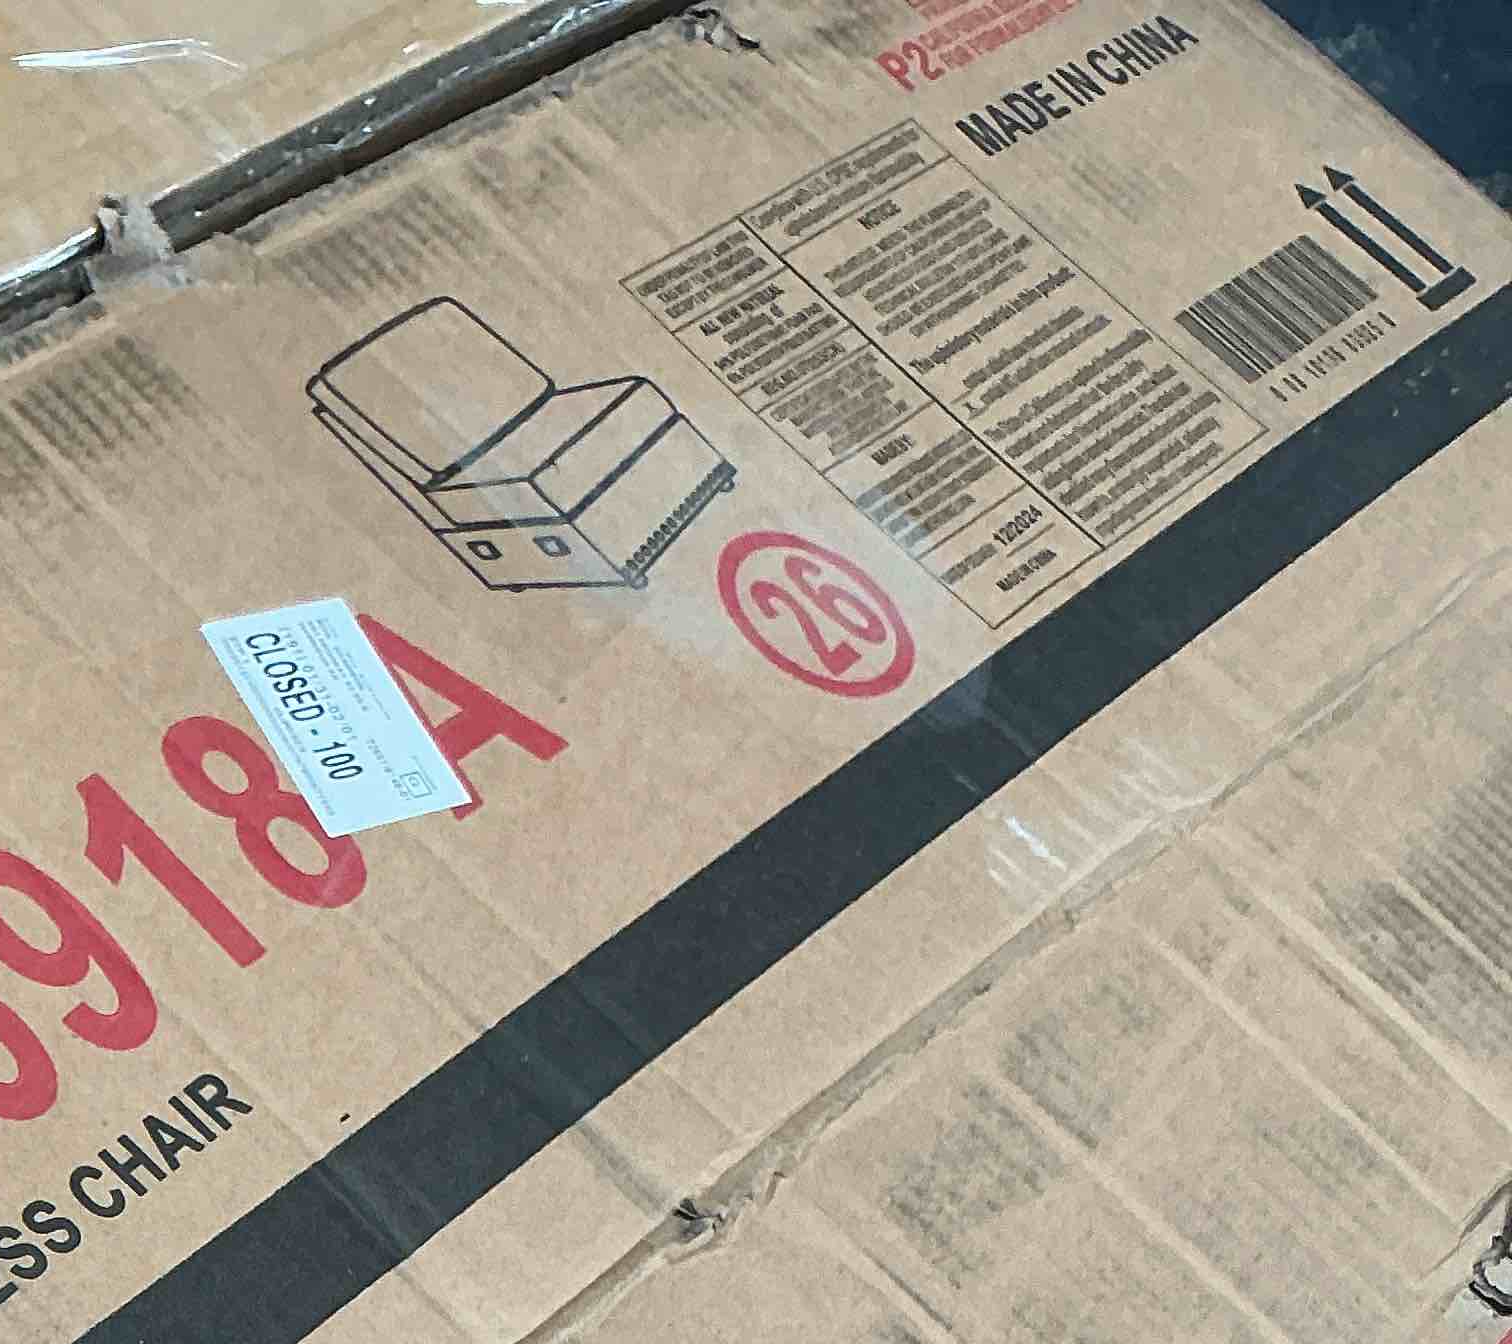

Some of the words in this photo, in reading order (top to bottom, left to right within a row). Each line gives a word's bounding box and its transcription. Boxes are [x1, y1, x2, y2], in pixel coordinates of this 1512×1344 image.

[955, 81, 1051, 156] MADE
[1028, 62, 1086, 106] IN
[1086, 15, 1199, 85] CHINA
[750, 556, 887, 676] 26
[245, 632, 324, 723] CLOSED
[312, 741, 363, 781] 100
[69, 1073, 254, 1218] CHAIR
